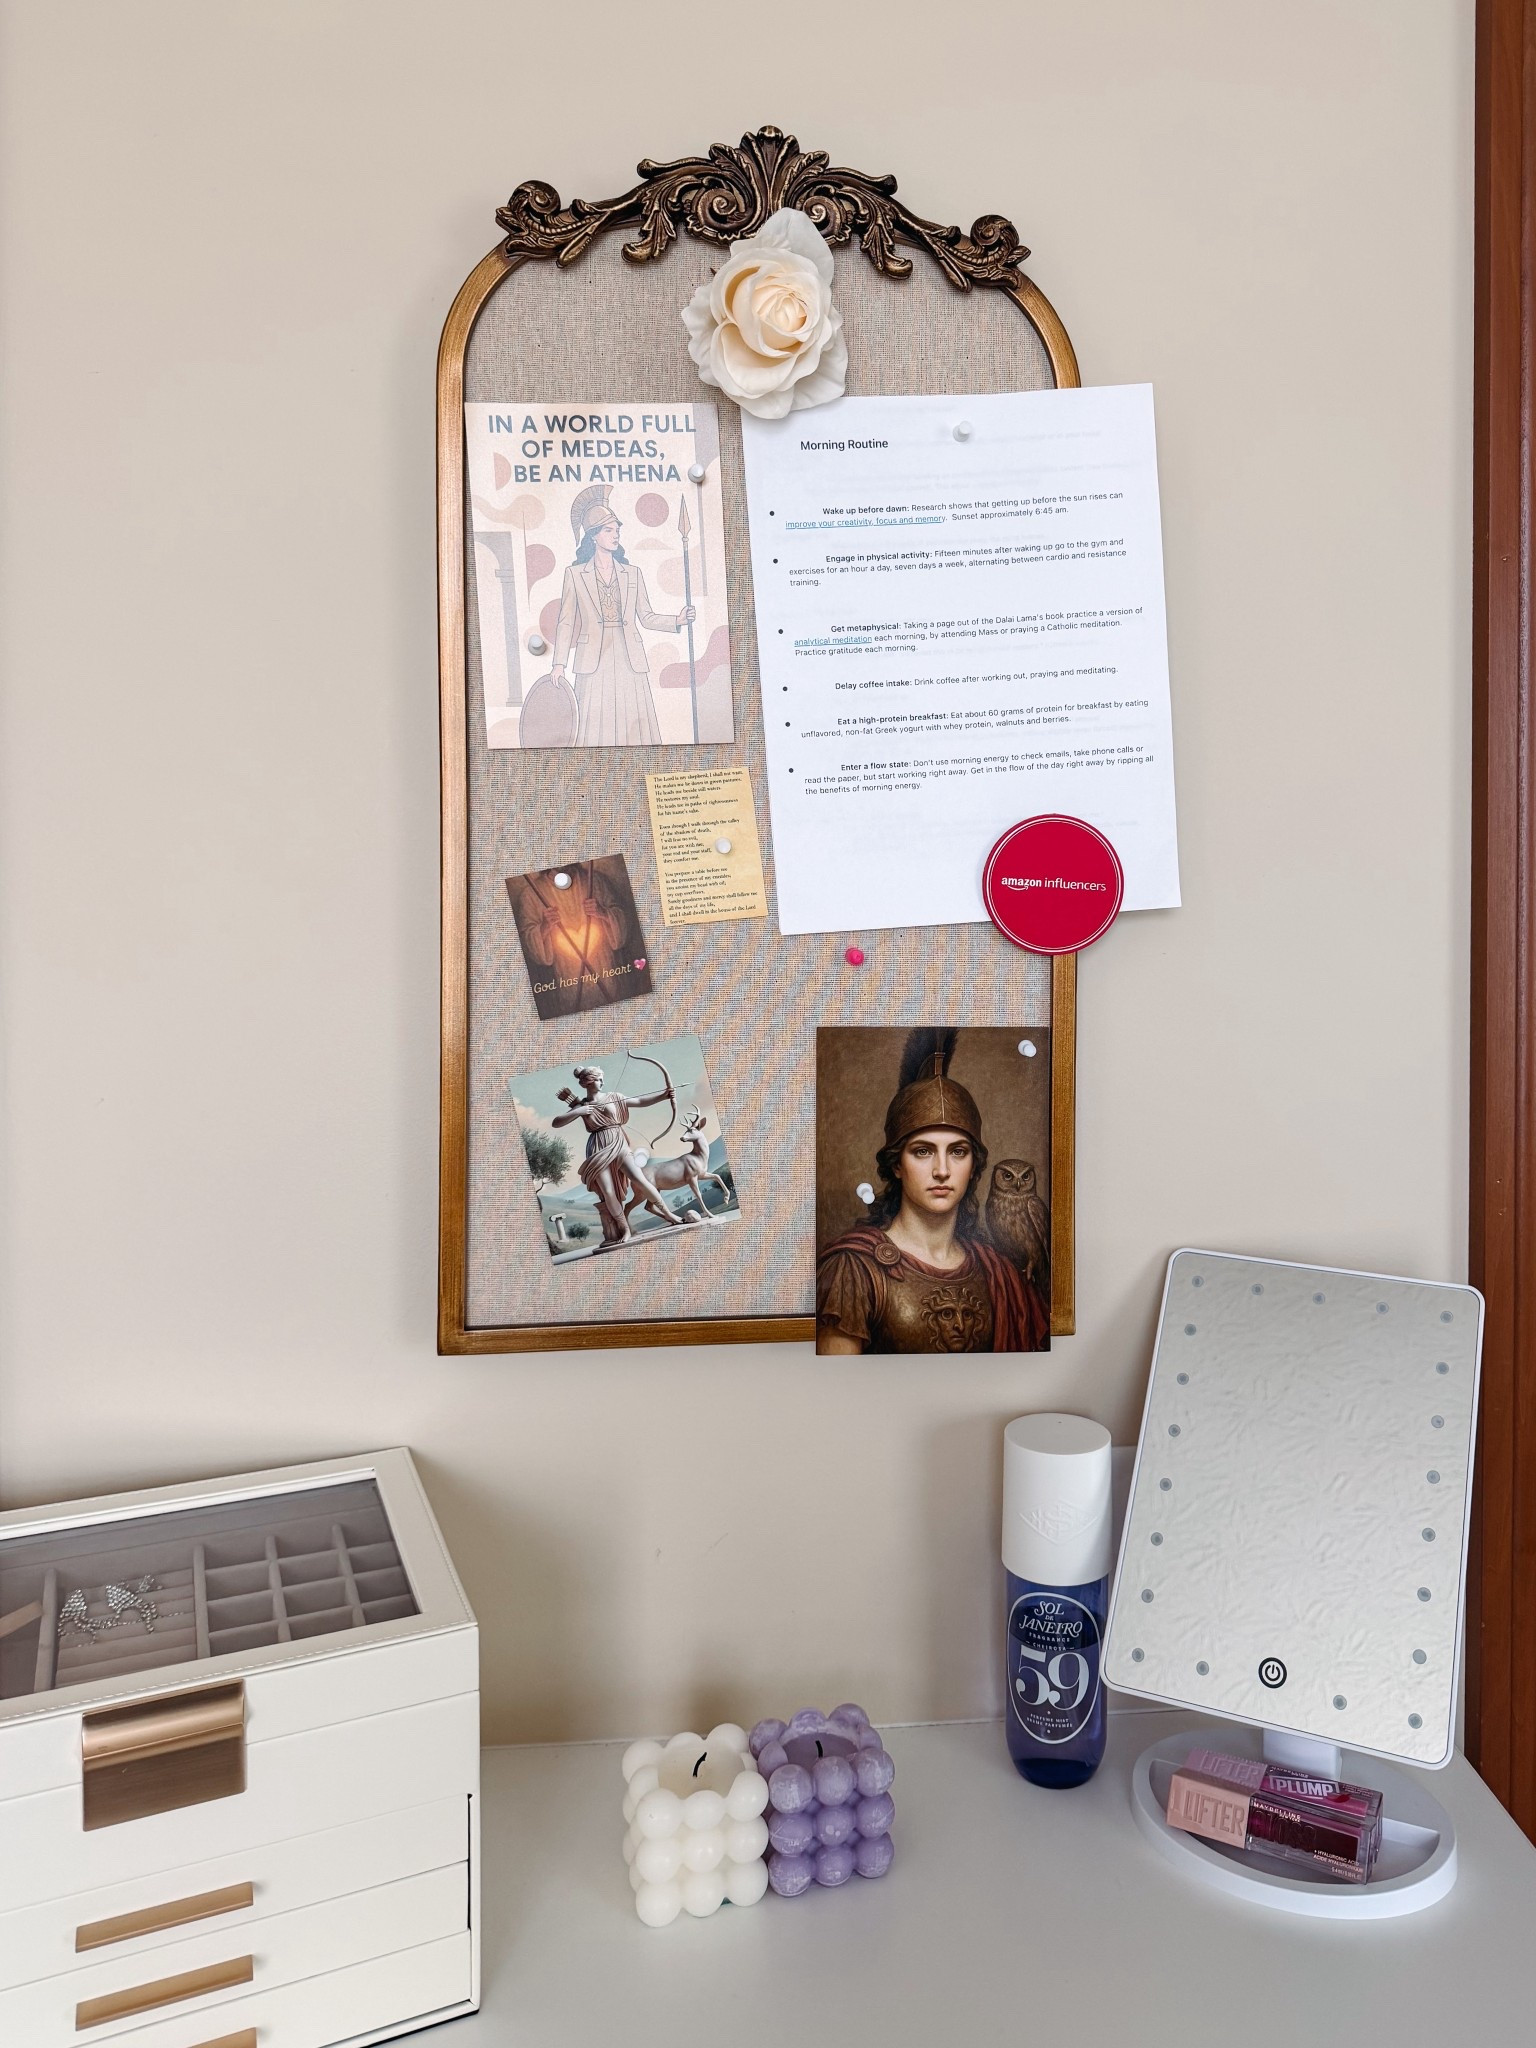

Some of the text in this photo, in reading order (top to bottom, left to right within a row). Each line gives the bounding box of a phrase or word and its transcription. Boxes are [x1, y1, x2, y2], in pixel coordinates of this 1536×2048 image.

[488, 414, 696, 433] IN A WORLD FULL
[522, 440, 665, 460] OF MEDEAS,
[800, 438, 889, 452] Morning Routine
[514, 464, 681, 483] BE AN ATHENA
[822, 507, 844, 515] Wake
[857, 506, 884, 514] before
[885, 505, 910, 513] dawn:
[911, 503, 947, 512] Research
[948, 502, 973, 510] shows
[974, 501, 990, 509] that
[991, 500, 1019, 509] getting
[1032, 496, 1057, 504] before
[785, 521, 817, 529] improve
[817, 520, 836, 528] your
[836, 518, 874, 528] creativity,
[876, 517, 898, 526] focus
[898, 517, 915, 525] and
[915, 516, 948, 525] memory.
[951, 513, 979, 521] Sunset
[979, 508, 1034, 520] approximately
[1035, 506, 1054, 516] 6:45
[825, 555, 856, 564] Engage
[866, 552, 899, 562] physical
[900, 550, 933, 560] activity:
[962, 548, 993, 556] minutes
[994, 546, 1013, 554] after
[1014, 545, 1041, 553] waking
[1054, 543, 1065, 551] go
[1090, 540, 1108, 549] gym
[1109, 538, 1124, 546] and
[830, 625, 845, 633] Get
[846, 622, 902, 632] metaphysical:
[903, 622, 928, 630] Taking
[936, 621, 956, 629] page
[971, 618, 980, 626] of
[995, 616, 1015, 624] Dalai
[1016, 614, 1044, 623] Lama's
[1045, 612, 1065, 620] book
[1066, 611, 1098, 620] practice
[1105, 608, 1134, 616] version
[1134, 606, 1143, 614] of
[794, 637, 831, 646] analytical
[832, 635, 873, 644] meditation
[874, 634, 893, 642] each
[894, 632, 928, 641] morning,
[929, 631, 939, 640] by
[940, 629, 977, 638] attending
[978, 628, 999, 636] Mass
[1010, 626, 1039, 635] praying
[1046, 622, 1078, 631] Catholic
[1080, 620, 1122, 628] meditation.
[828, 646, 863, 657] gratitude
[835, 682, 857, 691] Delay
[858, 680, 884, 689] coffee
[885, 679, 912, 687] intake:
[914, 678, 934, 686] Drink
[935, 676, 960, 685] coffee
[961, 675, 980, 683] after
[981, 674, 1012, 682] working
[1013, 672, 1028, 680] out,
[1030, 671, 1058, 679] praying
[1076, 667, 1118, 675] meditating.
[837, 718, 851, 726] Eat
[858, 714, 908, 725] high-protein
[909, 712, 949, 722] breakfast:
[964, 710, 987, 718] about
[988, 709, 999, 717] 60
[1000, 708, 1025, 717] grams
[1025, 706, 1034, 714] of
[1035, 704, 1063, 714] protein
[1076, 702, 1112, 710] breakfast
[1113, 701, 1124, 709] by
[1124, 700, 1149, 708] eating
[800, 729, 843, 738] unflavored,
[845, 727, 873, 736] non-fat
[874, 726, 898, 734] Greek
[899, 725, 924, 734] yogurt
[943, 722, 963, 731] whey
[964, 720, 994, 729] protein,
[995, 719, 1025, 727] walnuts
[1026, 716, 1041, 725] and
[1042, 716, 1072, 724] berries.
[1001, 877, 1106, 891] amazon influencers
[533, 964, 632, 994] God has my heart
[1034, 1601, 1065, 1616] SOL
[1019, 1615, 1083, 1638] JANEIRO
[1029, 1632, 1070, 1642] FRAGRANCE
[1032, 1642, 1066, 1651] CHEIROSA
[1016, 1644, 1090, 1711] 59
[1201, 1750, 1259, 1780] LIFTER
[1275, 1778, 1333, 1797] PLUMP
[1183, 1790, 1245, 1836] LIFTER
[1253, 1802, 1301, 1820] MAYBELLINE
